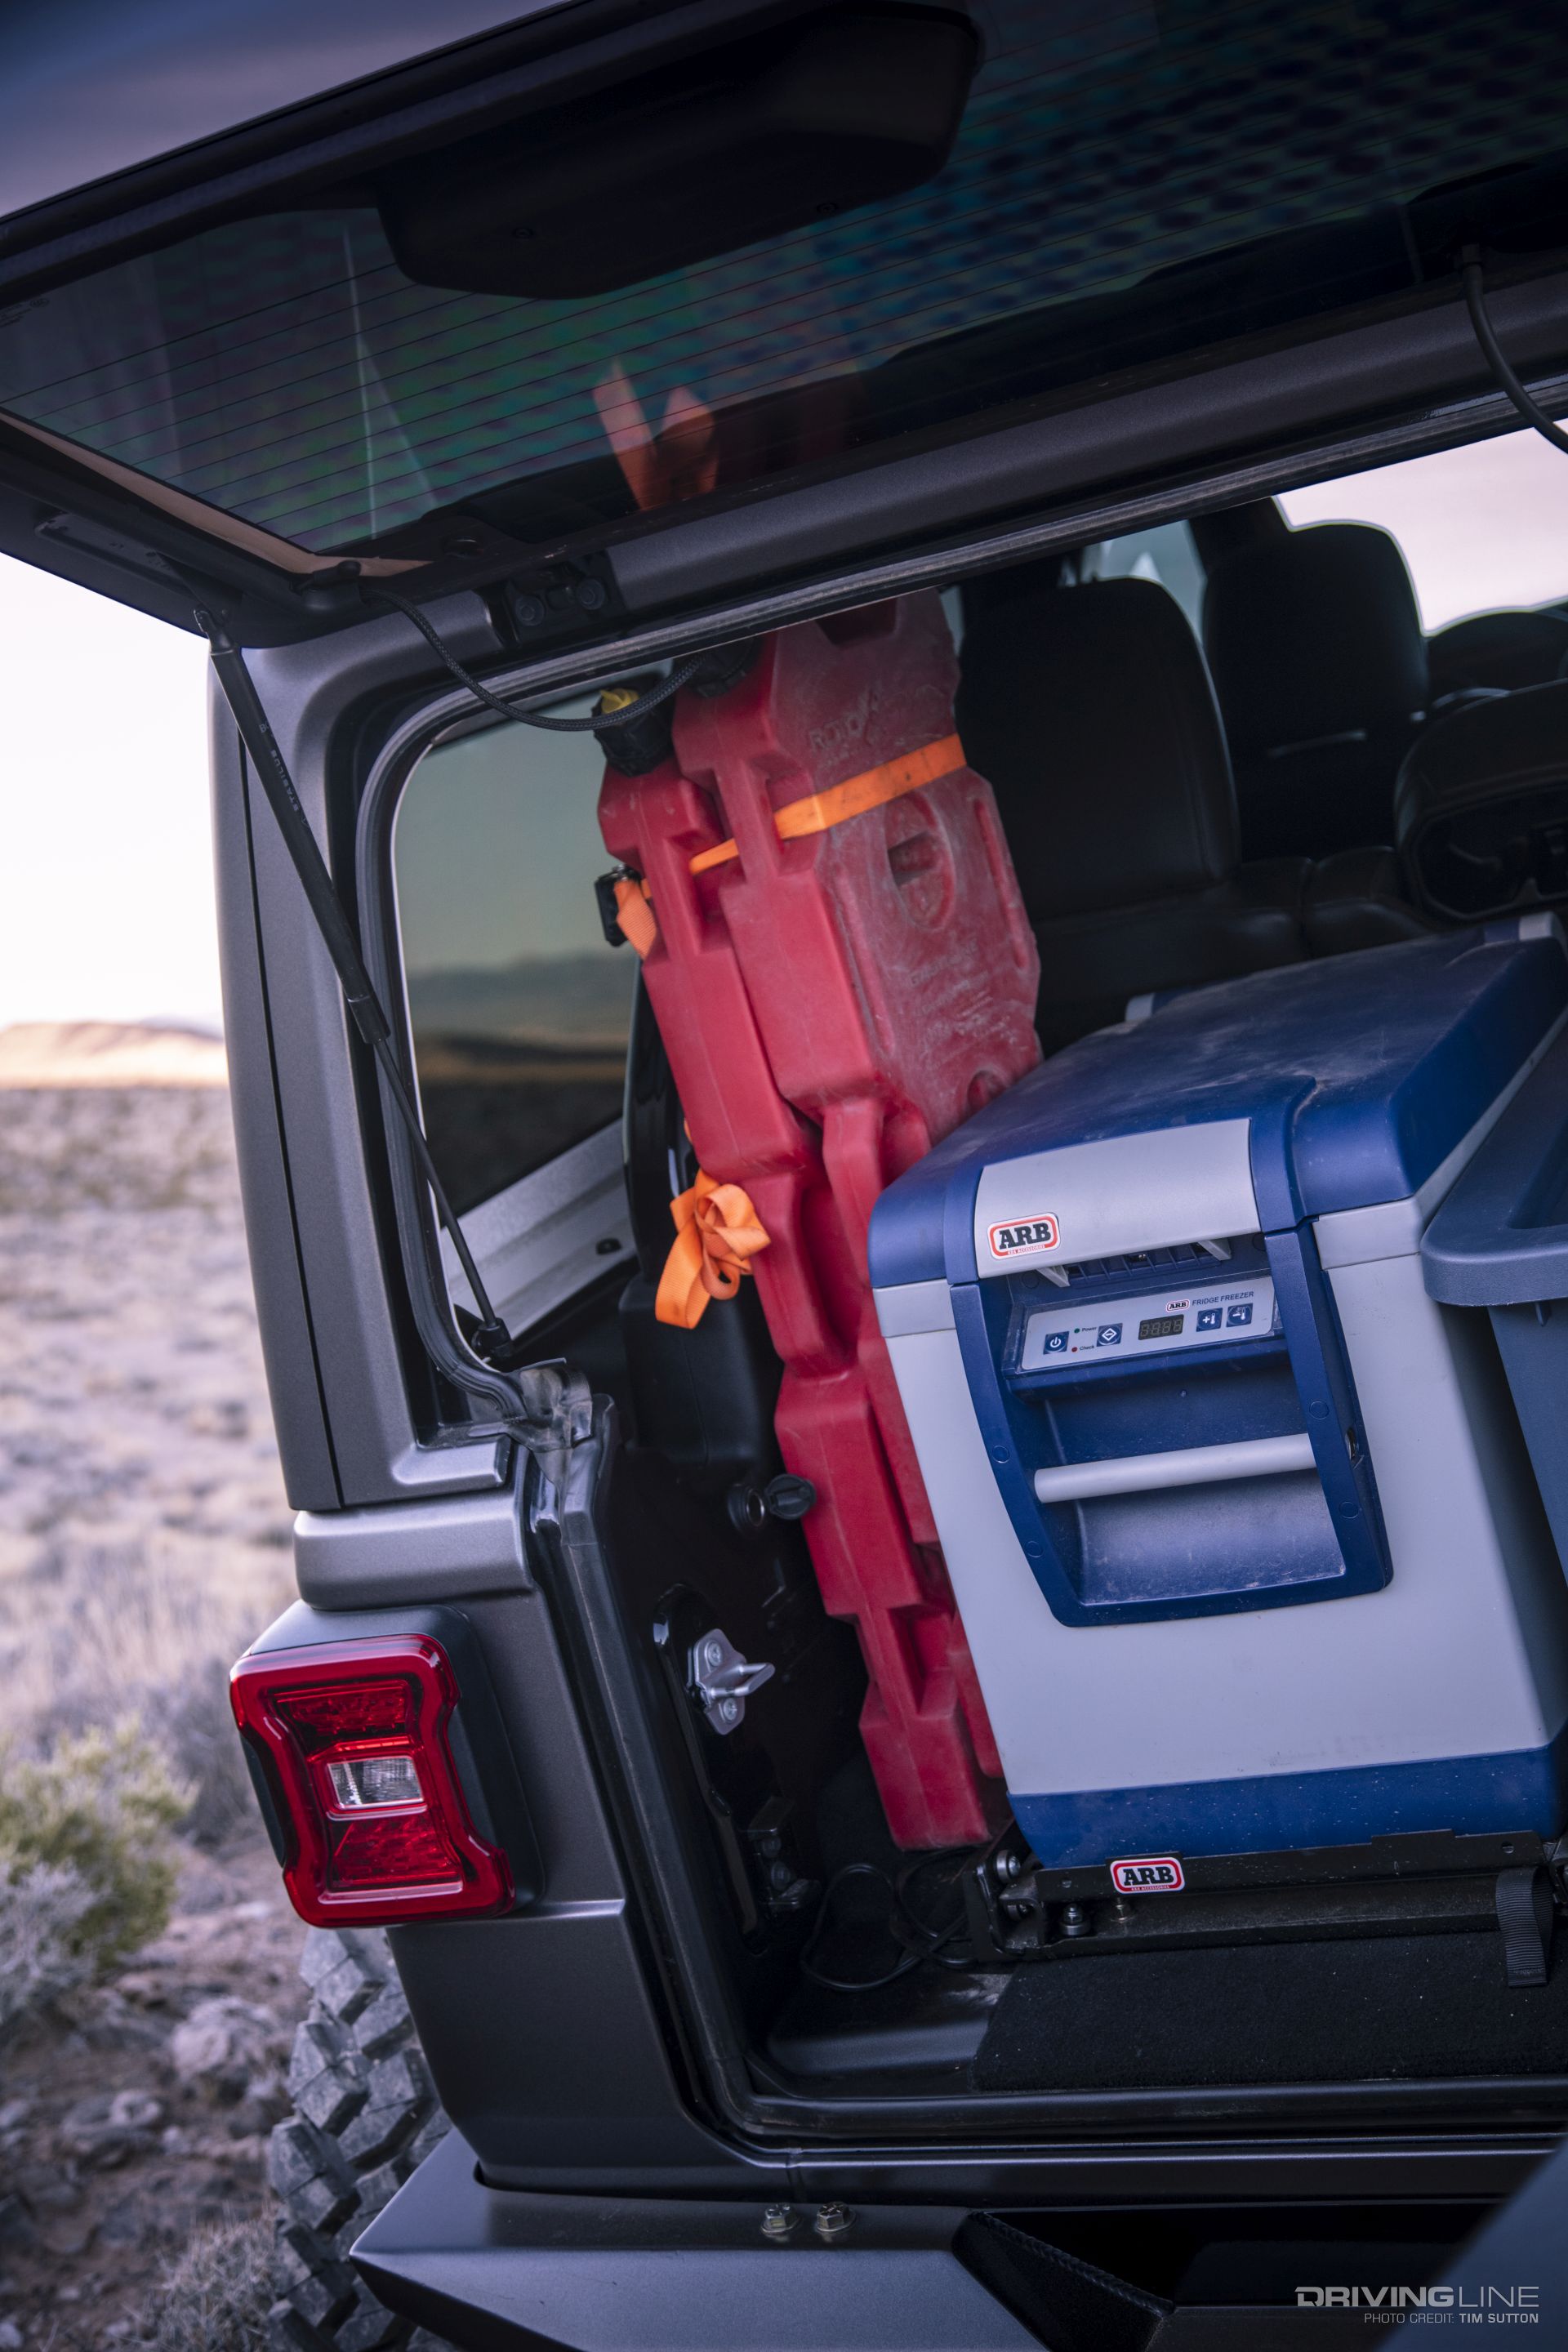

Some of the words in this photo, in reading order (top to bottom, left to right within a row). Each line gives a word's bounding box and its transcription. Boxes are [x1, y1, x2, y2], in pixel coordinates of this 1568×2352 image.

[999, 1223, 1052, 1250] ARB
[1169, 1302, 1187, 1310] ARB
[1192, 1296, 1219, 1307] FRIDGE
[1220, 1291, 1254, 1302] FREEZER
[1123, 1866, 1174, 1886] ARB
